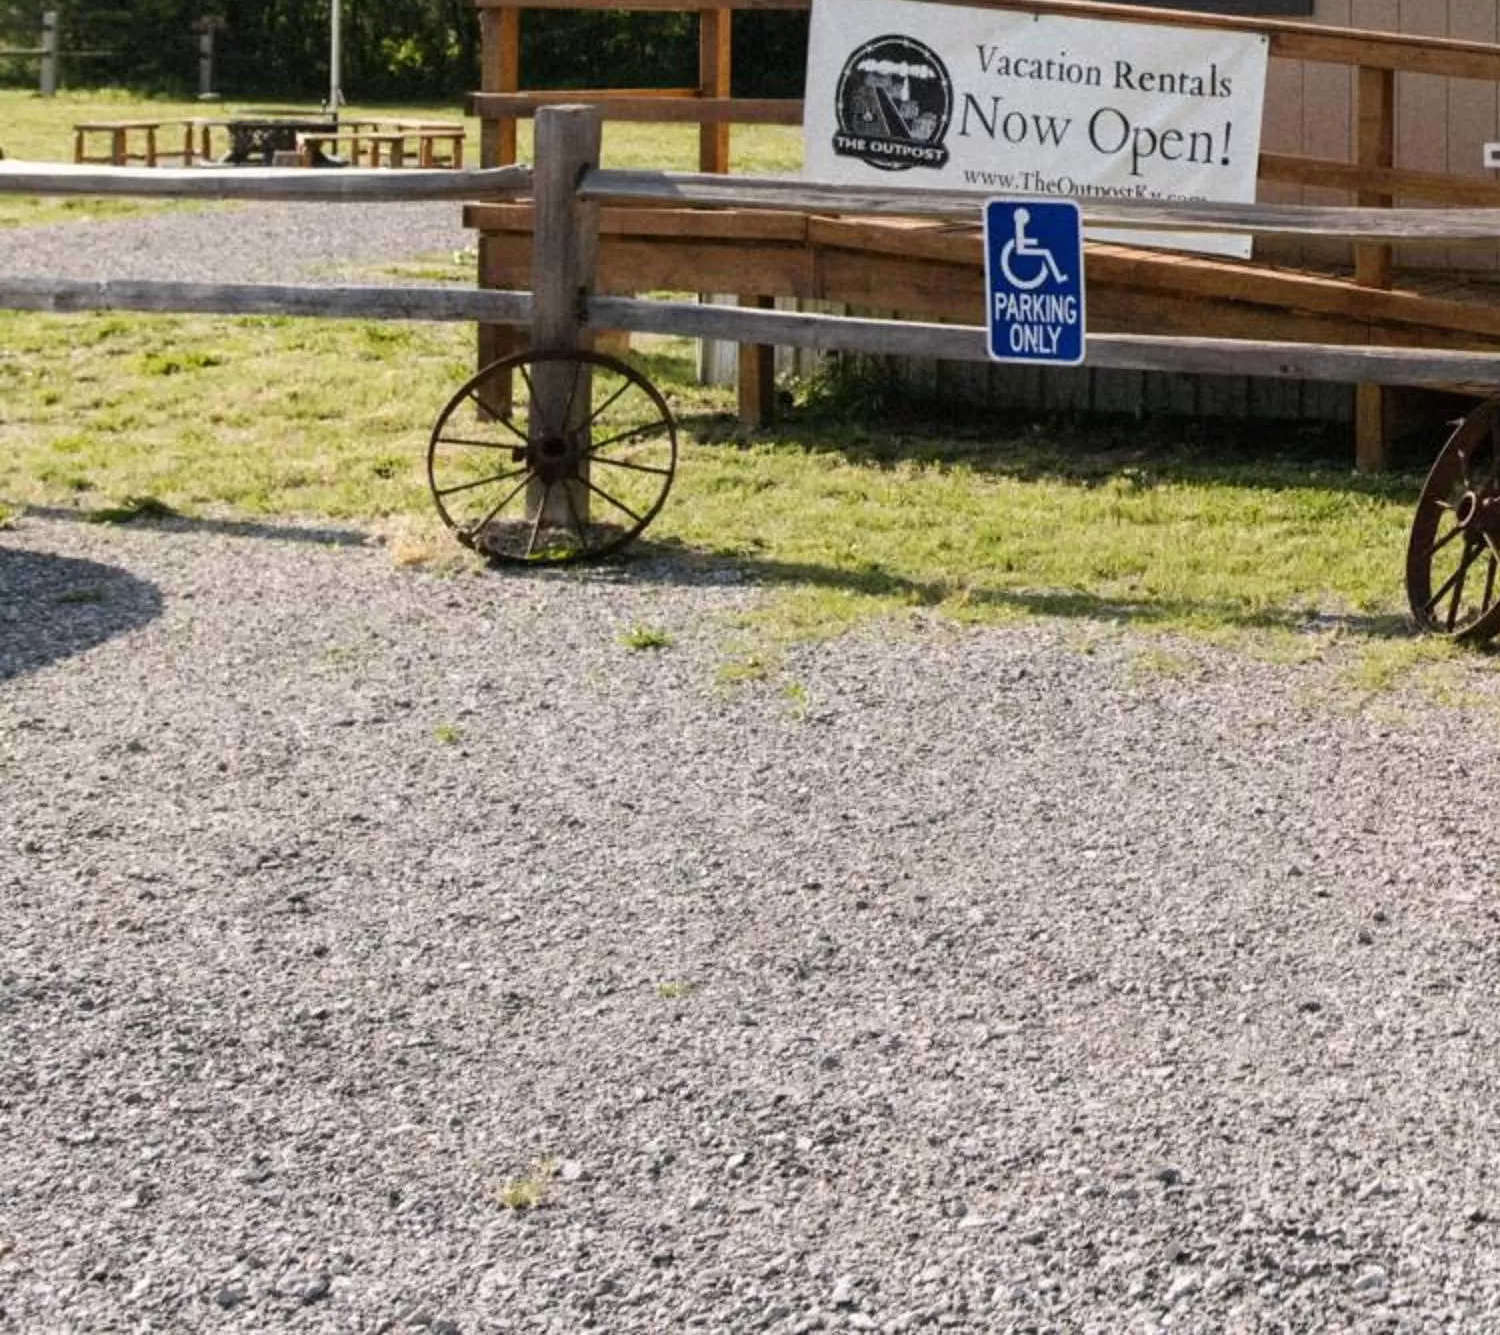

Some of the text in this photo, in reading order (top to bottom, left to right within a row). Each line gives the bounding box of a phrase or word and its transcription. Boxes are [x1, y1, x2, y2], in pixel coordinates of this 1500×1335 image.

[976, 44, 1233, 98] Vacation Rentals
[837, 136, 945, 161] THE OUTPOST
[958, 92, 1233, 176] Now Open!
[994, 292, 1077, 325] PARKING
[1009, 323, 1062, 355] ONLY
